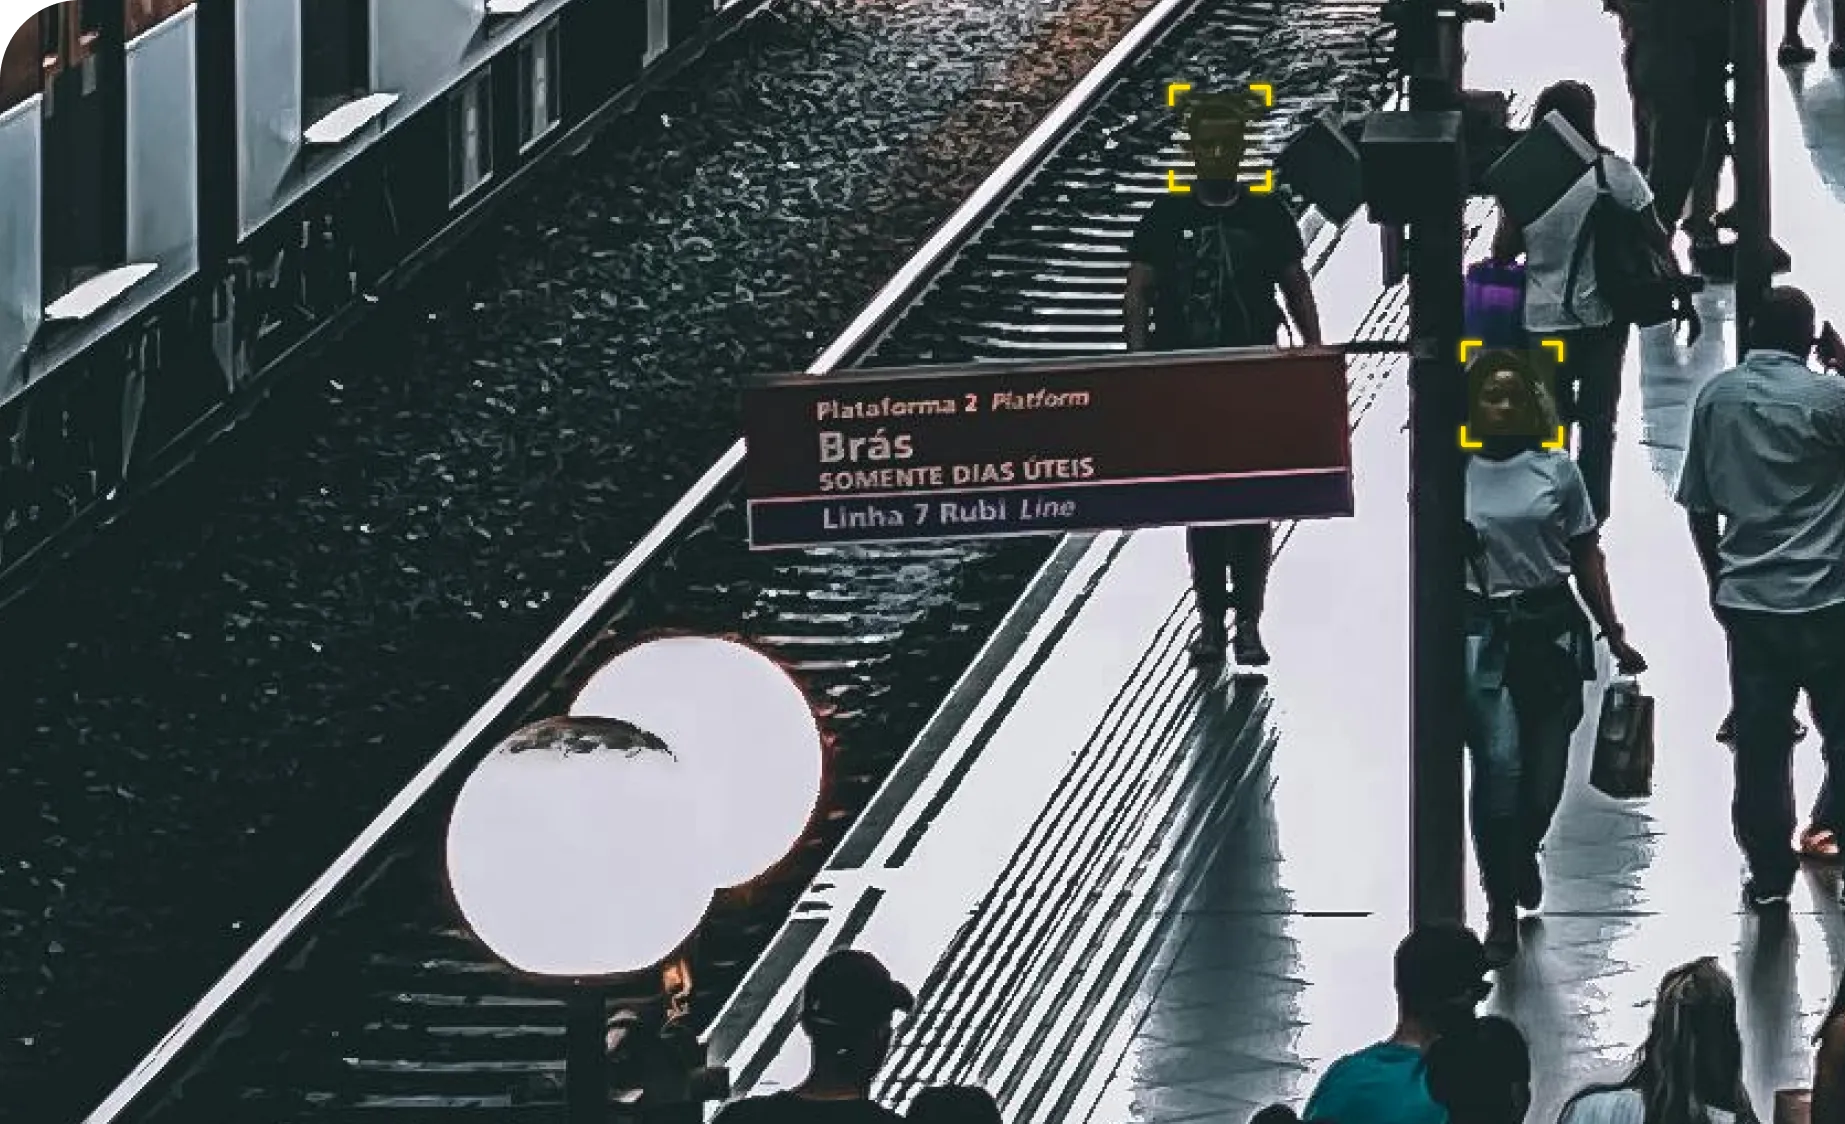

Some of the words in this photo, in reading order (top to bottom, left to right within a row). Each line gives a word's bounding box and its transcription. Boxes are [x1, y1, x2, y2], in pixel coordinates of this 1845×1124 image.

[816, 397, 955, 421] Plataforma
[964, 392, 979, 413] 2
[991, 388, 1091, 411] Platform
[819, 427, 914, 463] Brás
[819, 465, 943, 492] SOMENTE
[953, 460, 1015, 486] DIAS
[1022, 455, 1095, 481] ÚTEIS
[823, 504, 904, 530] Linha
[914, 503, 929, 525] 7
[940, 500, 1007, 525] Rubi
[1019, 497, 1077, 520] Line
